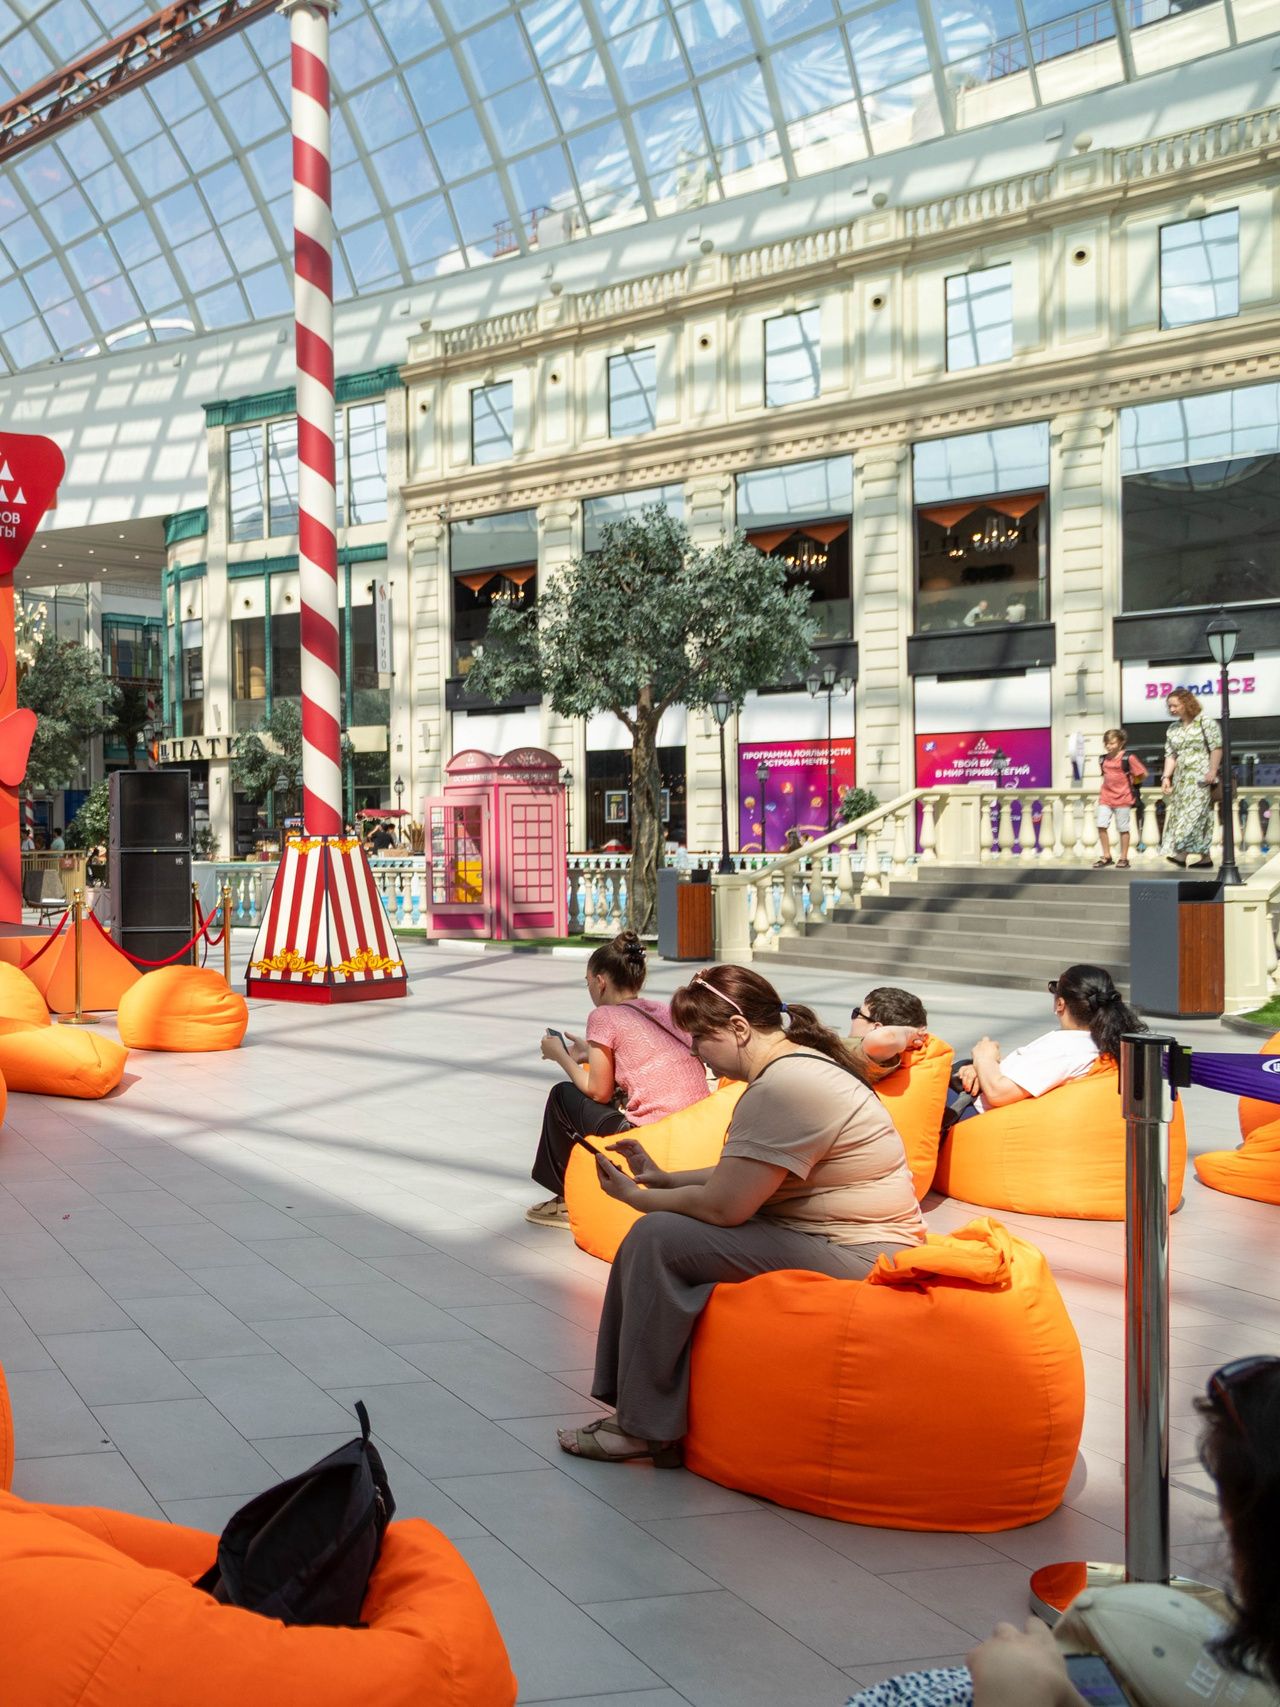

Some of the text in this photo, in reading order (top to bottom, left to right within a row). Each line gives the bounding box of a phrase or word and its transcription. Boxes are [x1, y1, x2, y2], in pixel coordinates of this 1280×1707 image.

[742, 749, 793, 760] ПРОГРАММА
[952, 757, 978, 768] ТВОЙ
[943, 768, 964, 777] МИР
